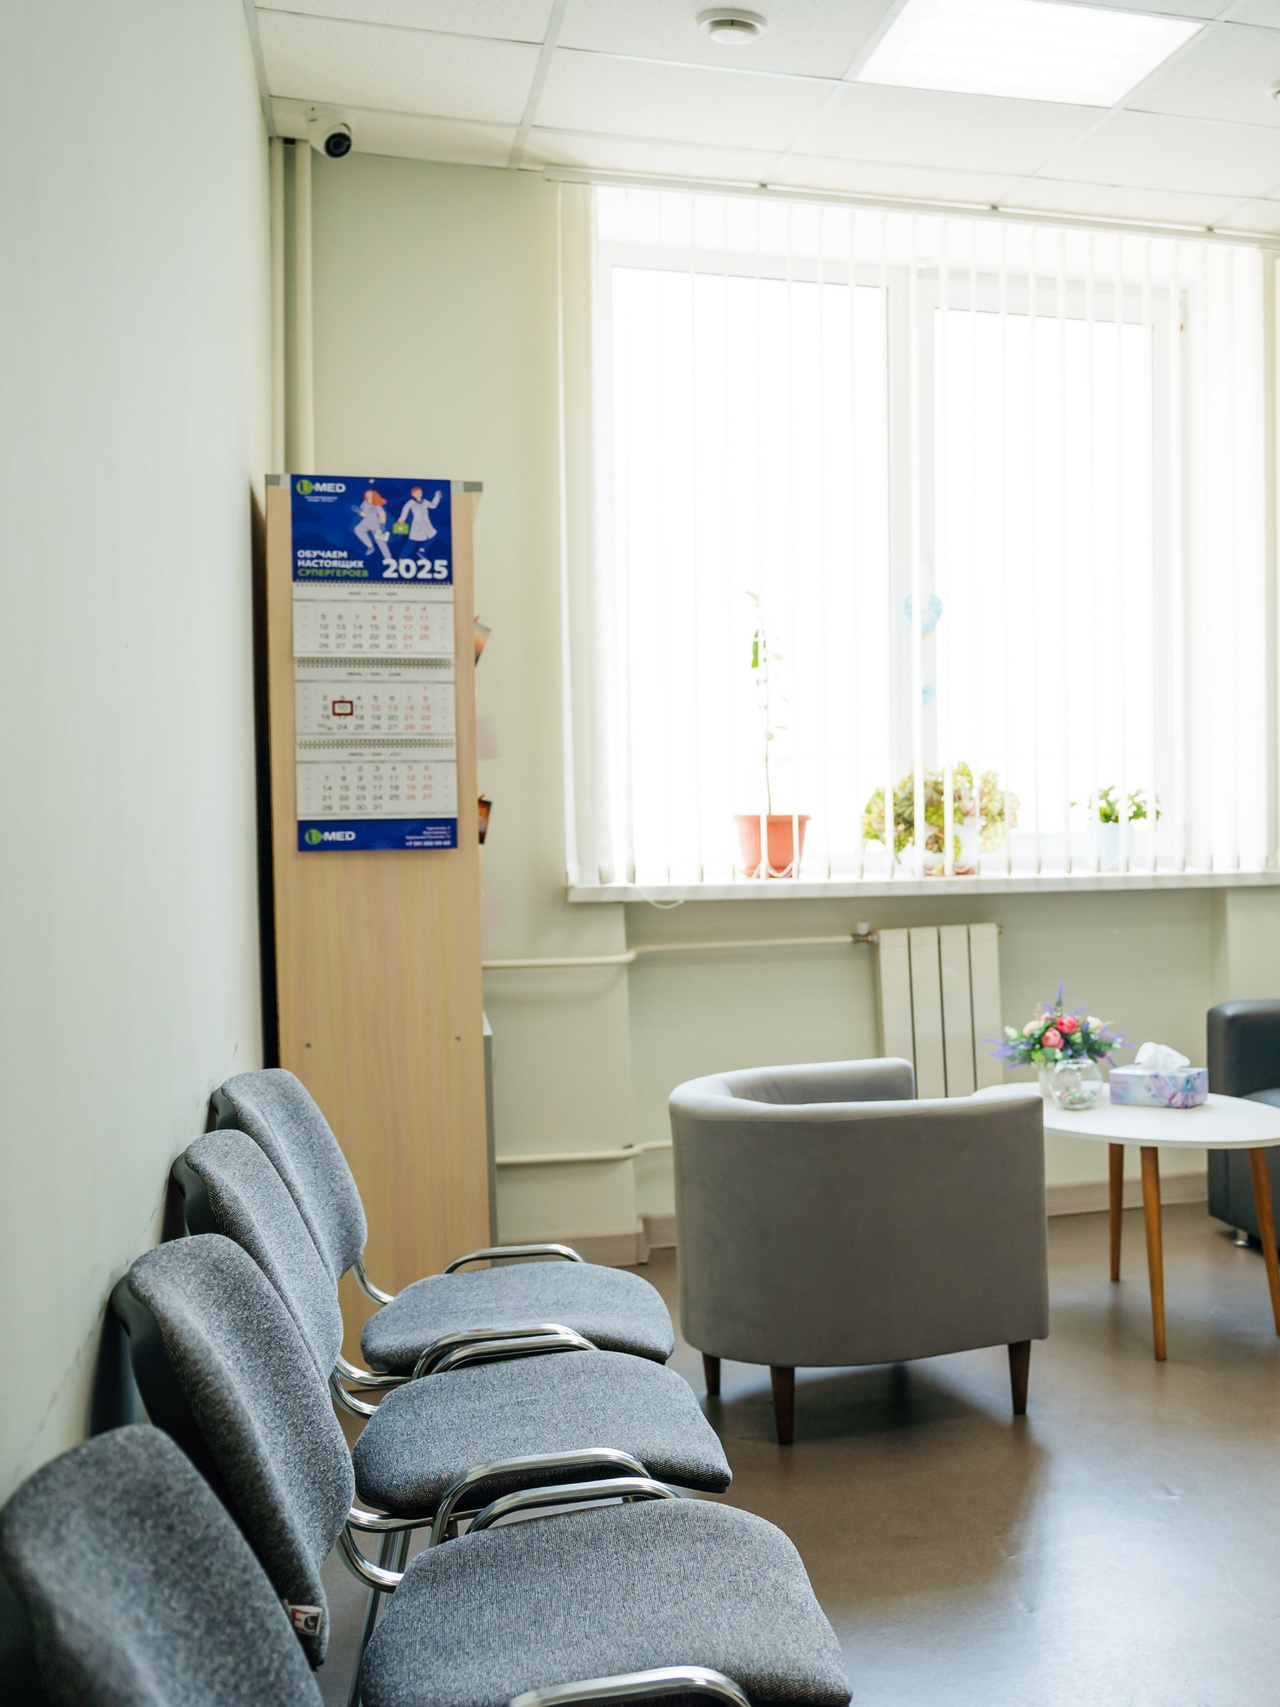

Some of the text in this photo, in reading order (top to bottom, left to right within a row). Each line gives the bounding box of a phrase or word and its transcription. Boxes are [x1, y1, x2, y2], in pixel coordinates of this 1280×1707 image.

[297, 550, 348, 558] ОБУЧАЕМ
[297, 559, 364, 569] НАСТОЯЩИХ
[297, 568, 369, 577] СУПЕРГЕРОЕВ
[382, 559, 449, 579] 2025
